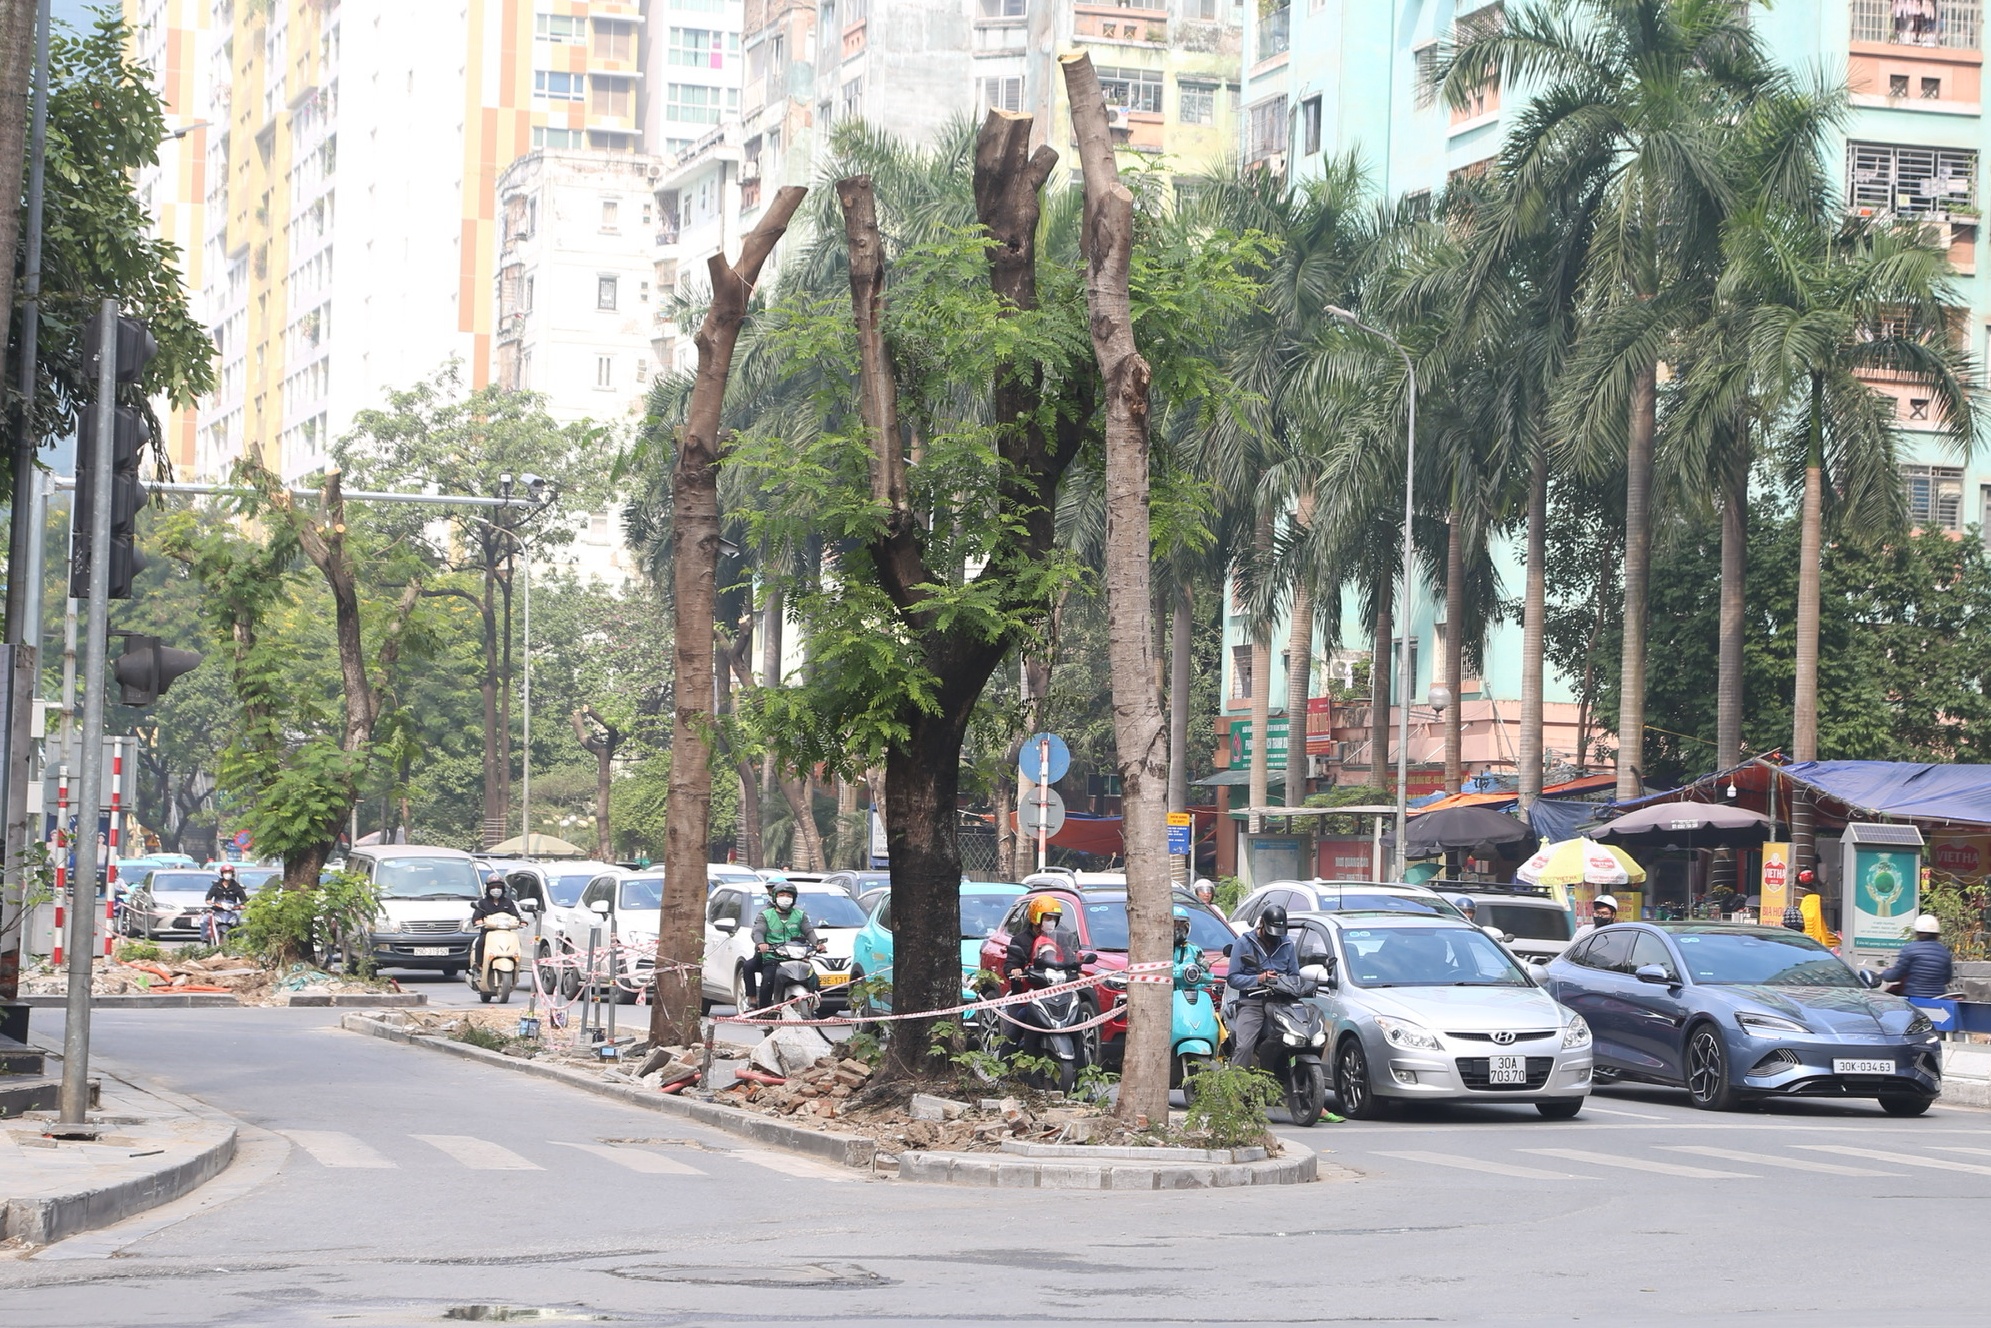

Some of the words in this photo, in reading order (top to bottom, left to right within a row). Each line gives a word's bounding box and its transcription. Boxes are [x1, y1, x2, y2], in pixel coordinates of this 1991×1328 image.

[1498, 1057, 1517, 1069] 30A
[1840, 1062, 1890, 1072] 30K-034.63
[1490, 1070, 1524, 1082] 703.70
